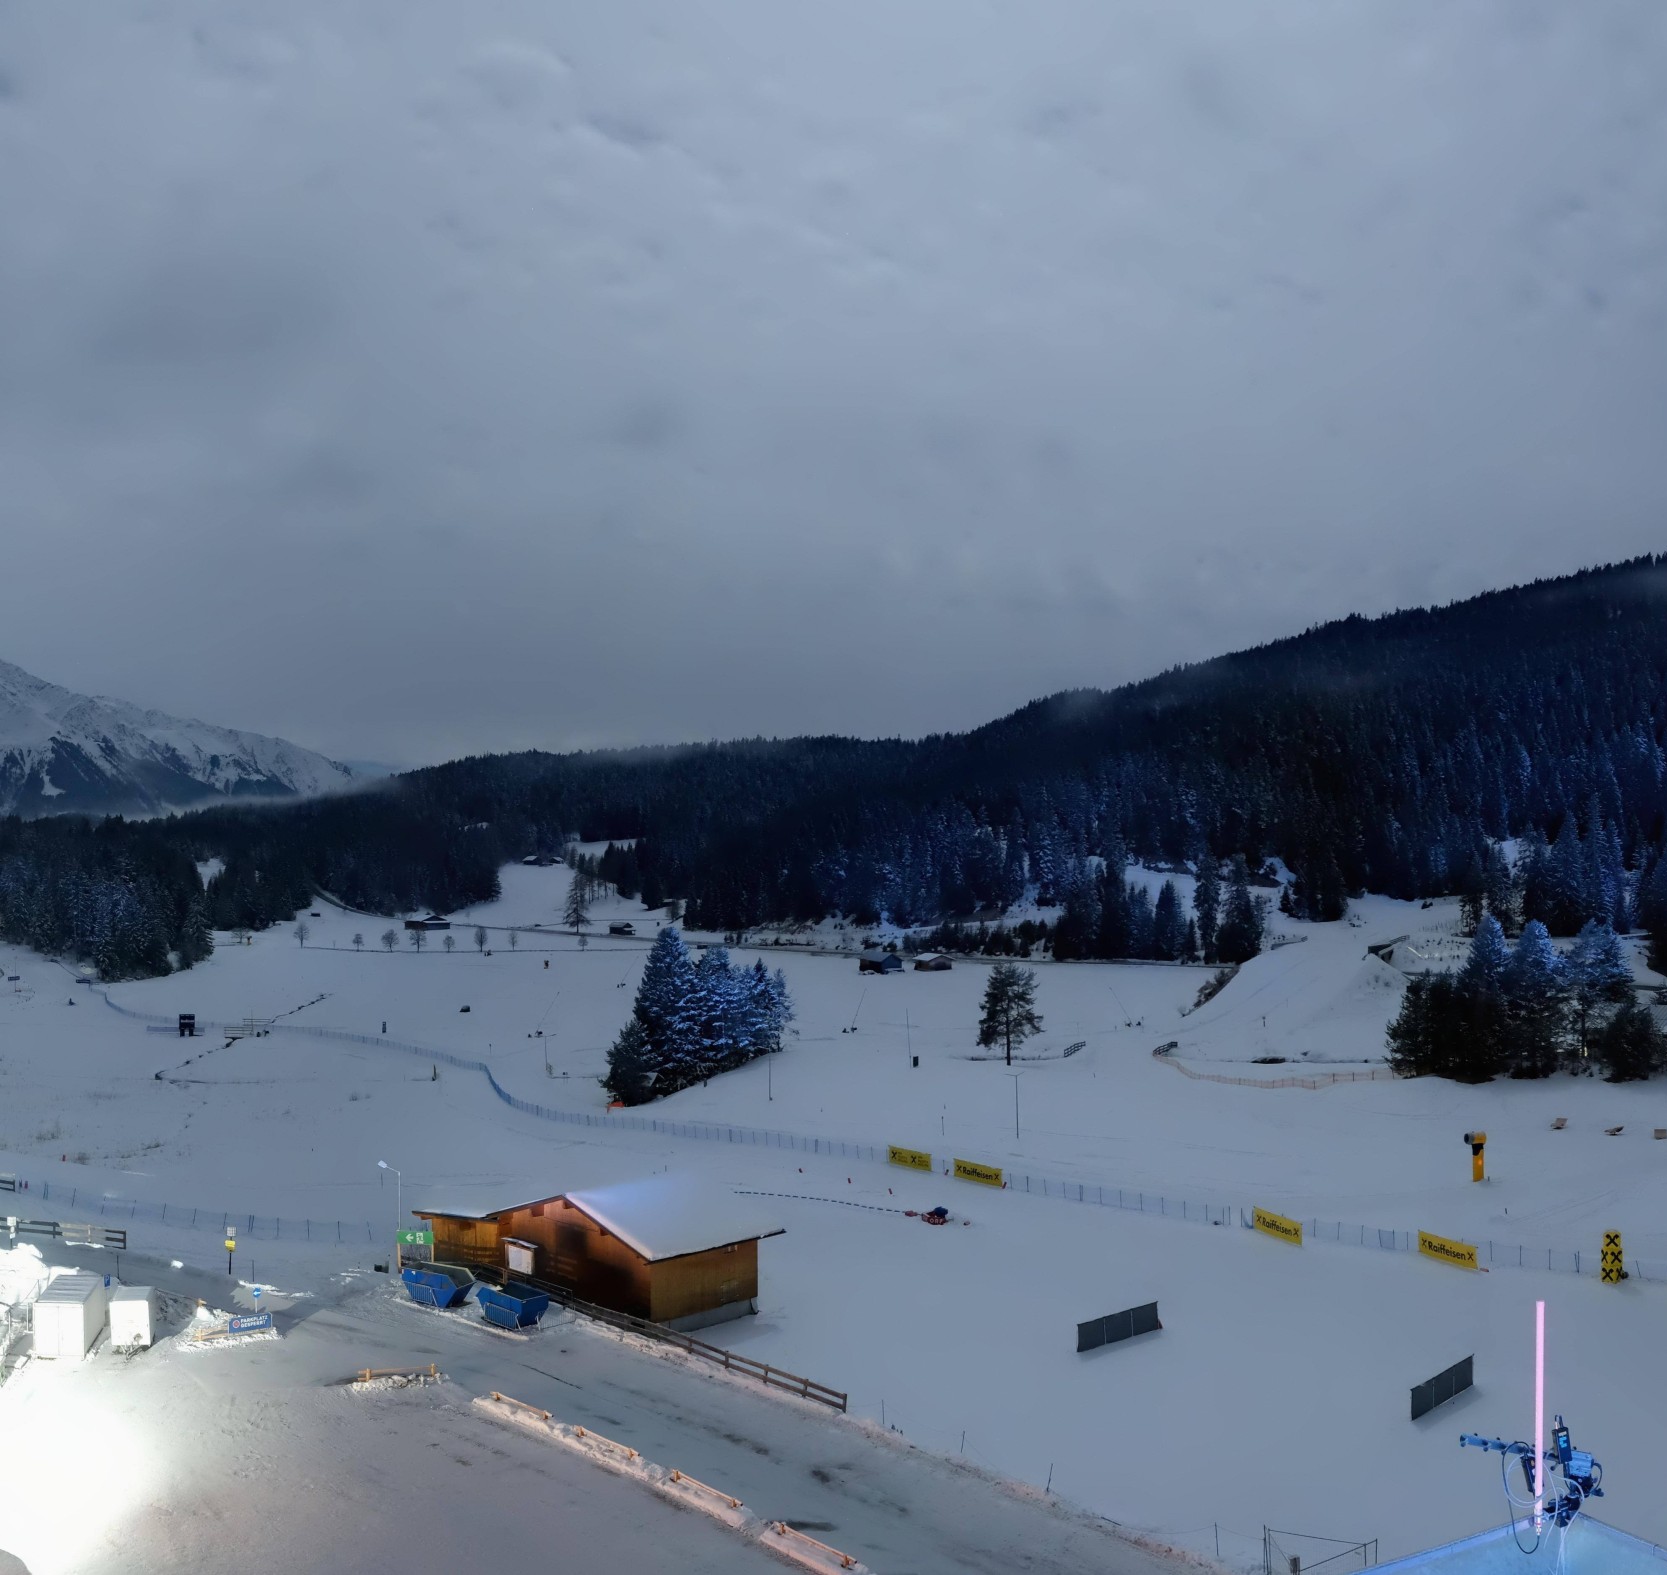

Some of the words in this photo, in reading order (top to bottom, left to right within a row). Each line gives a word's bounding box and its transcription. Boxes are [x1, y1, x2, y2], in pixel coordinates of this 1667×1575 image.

[962, 1166, 993, 1180] Raiffeisen
[1262, 1216, 1293, 1236] Raiffeisen
[1427, 1239, 1466, 1261] Raiffeisen
[240, 1315, 268, 1324] PARKPLATZ
[241, 1320, 266, 1328] GESPERRT
